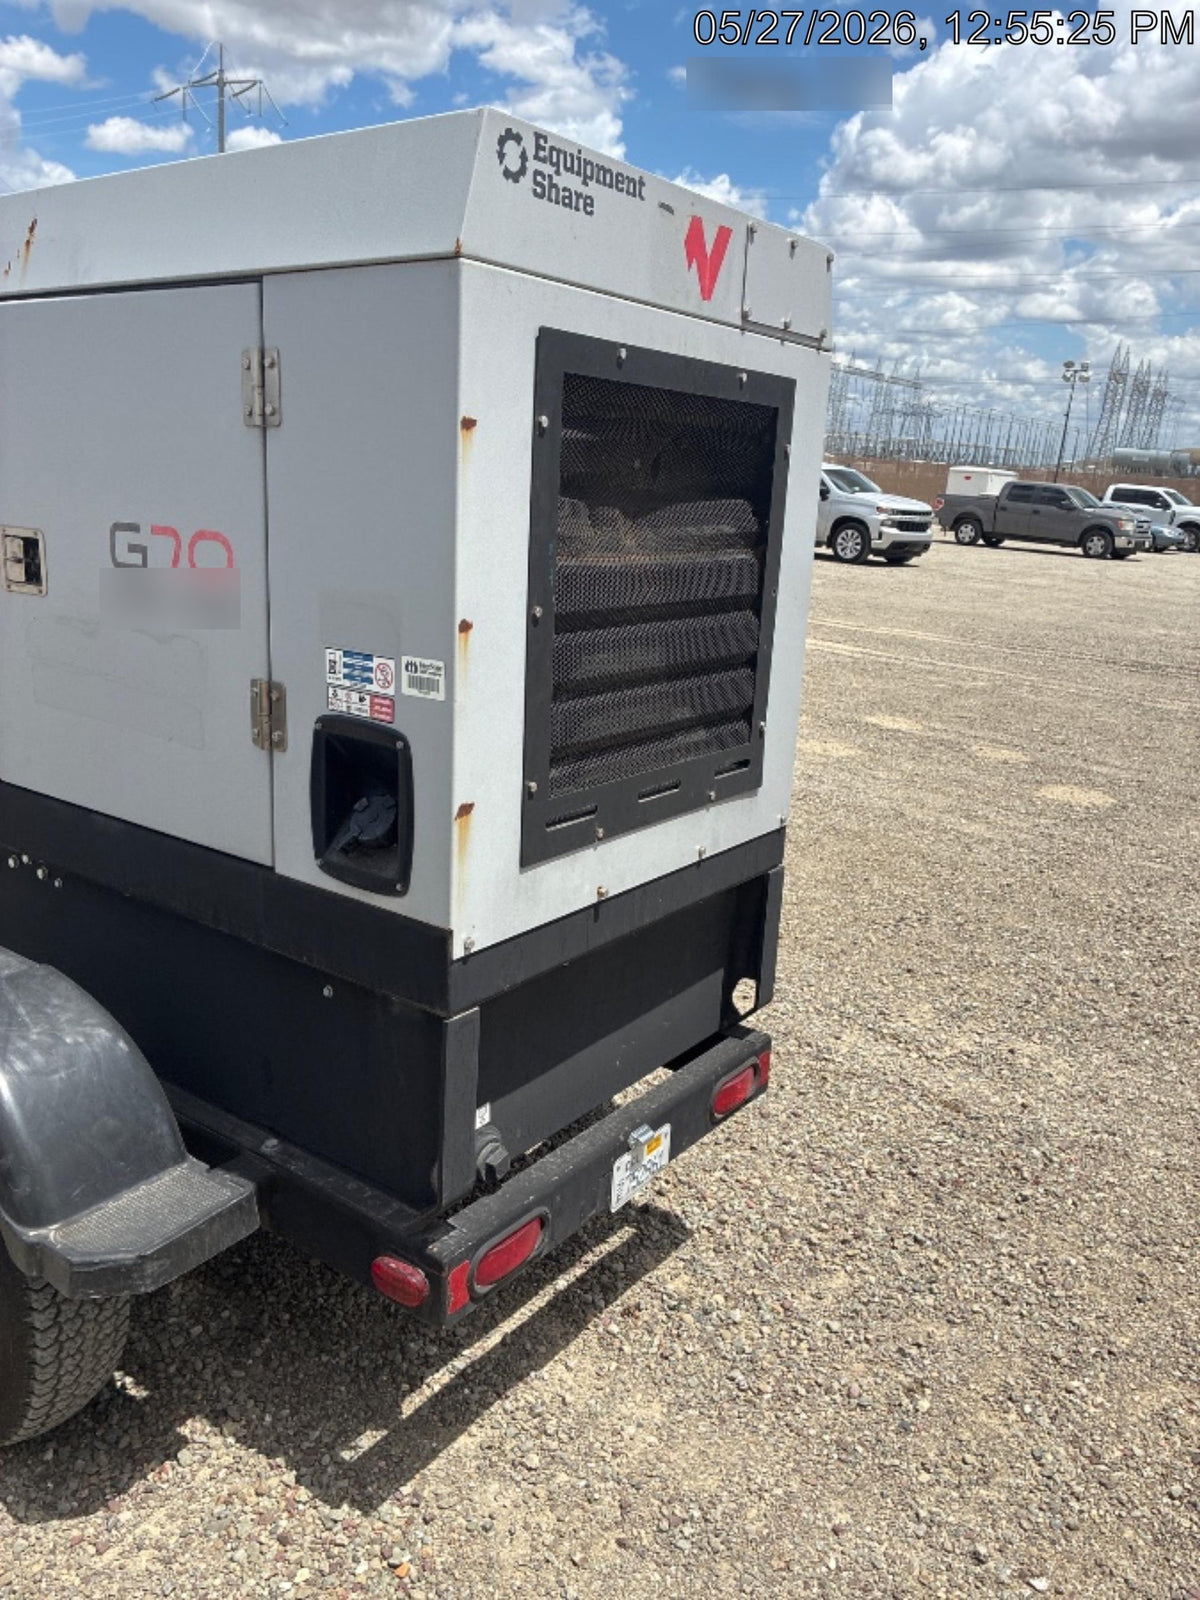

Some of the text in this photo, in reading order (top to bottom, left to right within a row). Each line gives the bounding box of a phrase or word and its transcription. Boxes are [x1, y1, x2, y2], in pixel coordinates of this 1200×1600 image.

[532, 131, 646, 202] Equipment
[532, 169, 595, 217] Share
[110, 522, 234, 569] G70
